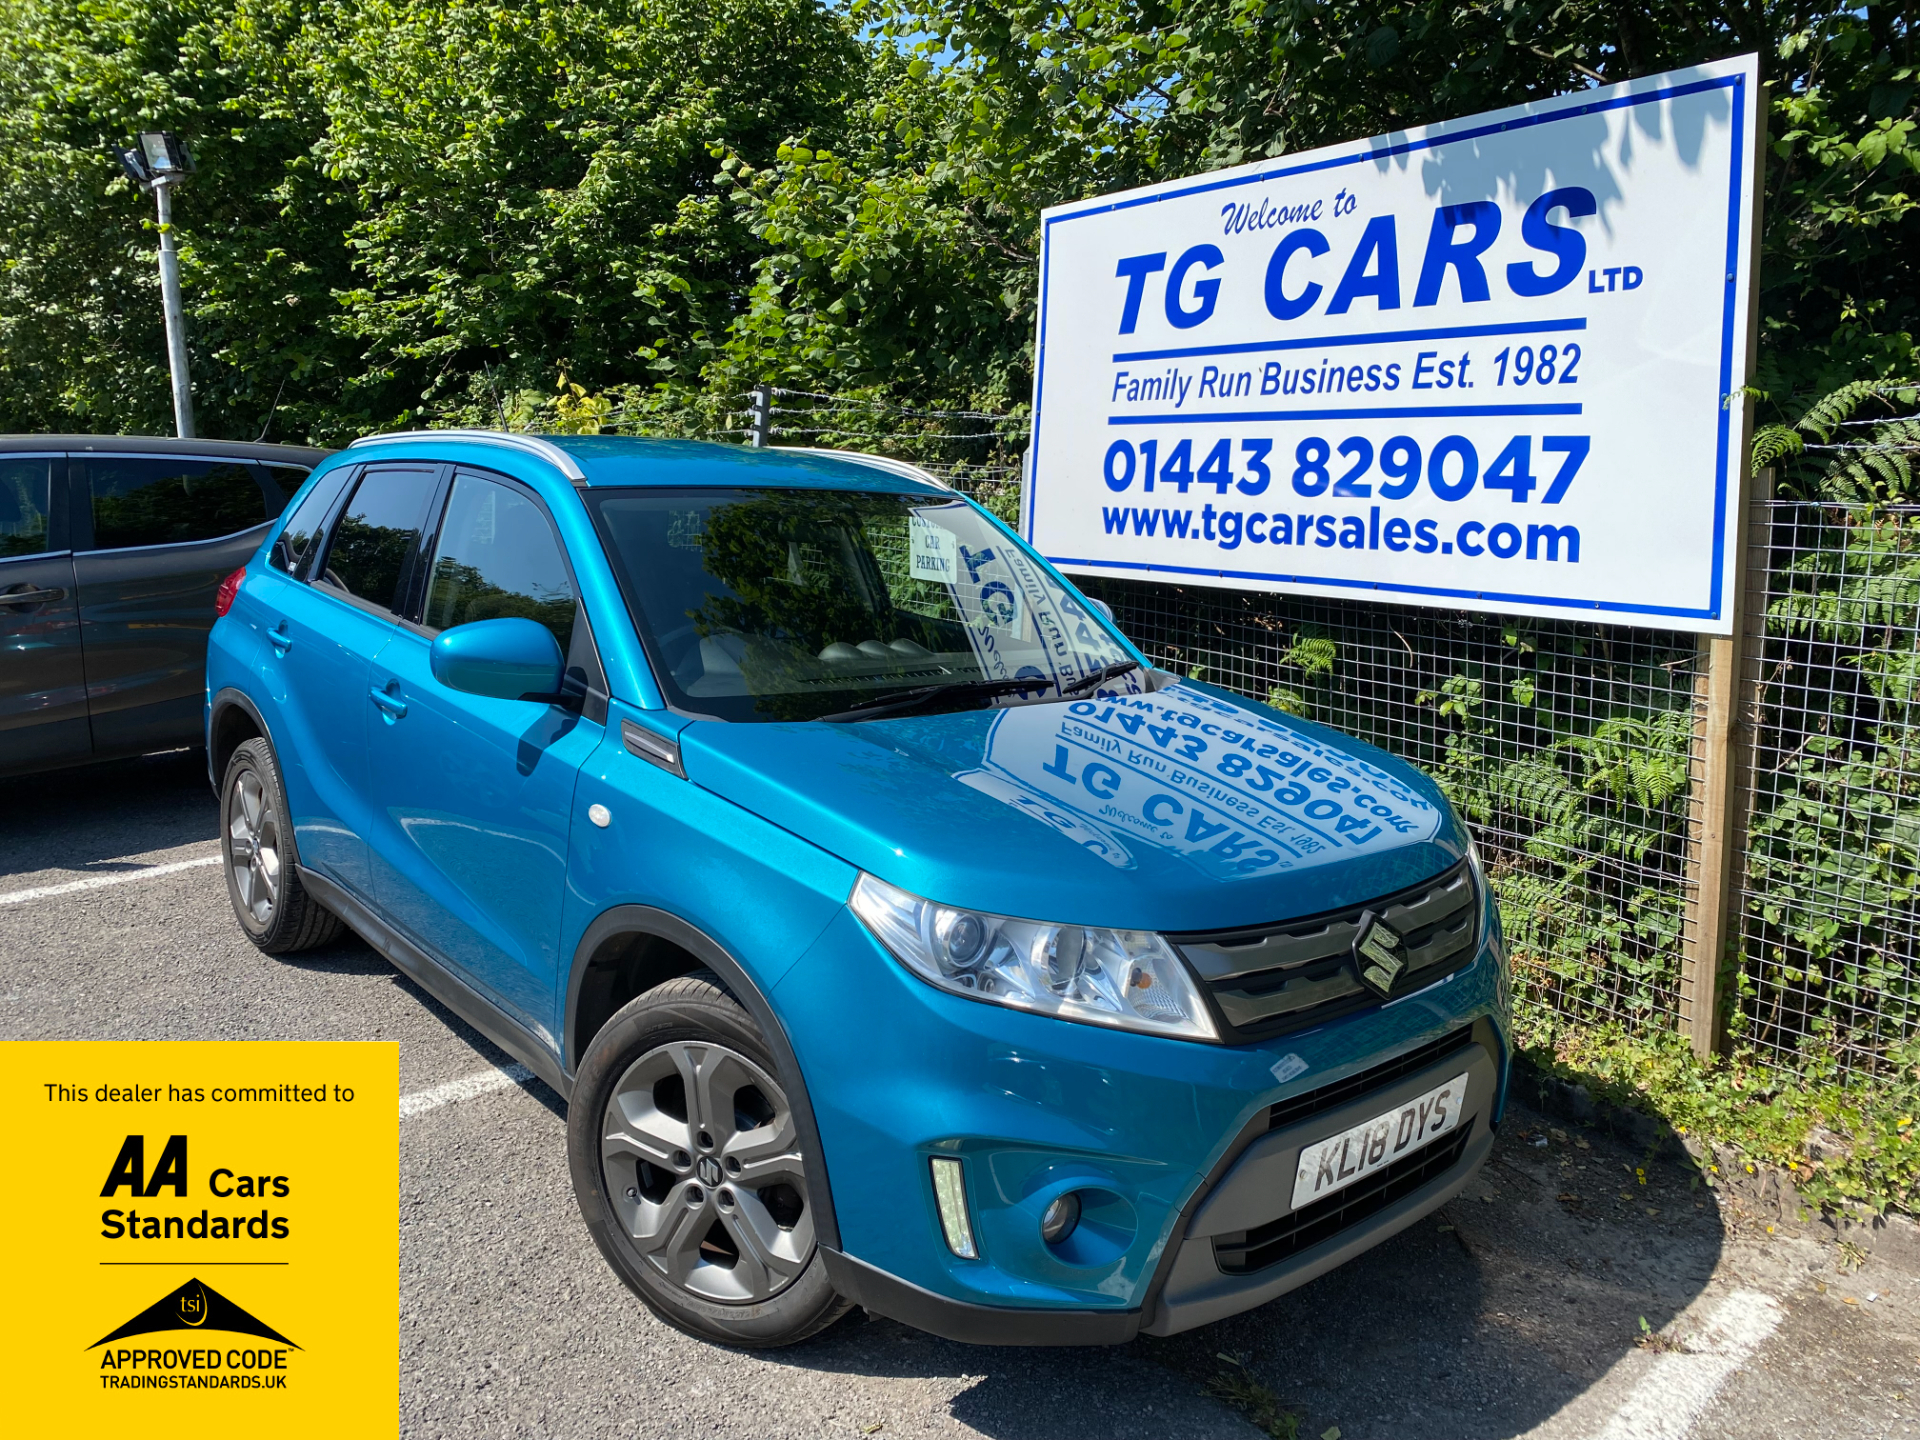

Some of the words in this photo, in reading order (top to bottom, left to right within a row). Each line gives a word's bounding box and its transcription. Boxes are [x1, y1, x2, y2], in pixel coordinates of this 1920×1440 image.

[1221, 197, 1324, 236] Welcome
[1333, 187, 1357, 216] to
[1116, 243, 1225, 335] TG
[1264, 186, 1597, 322] CARS
[1588, 265, 1643, 294] LTD
[1112, 368, 1192, 409] Family
[1198, 370, 1252, 398] Run
[1260, 357, 1401, 396] Business
[1411, 351, 1474, 390] Est.
[1493, 342, 1582, 387] 1982
[1103, 438, 1273, 495] 01443
[1291, 435, 1591, 505] 829047
[916, 555, 950, 572] PARKING
[925, 535, 940, 550] CAR
[1102, 504, 1581, 563] www.tgcarsales.com
[1314, 1120, 1391, 1193] KL18
[1393, 1089, 1451, 1154] DYS
